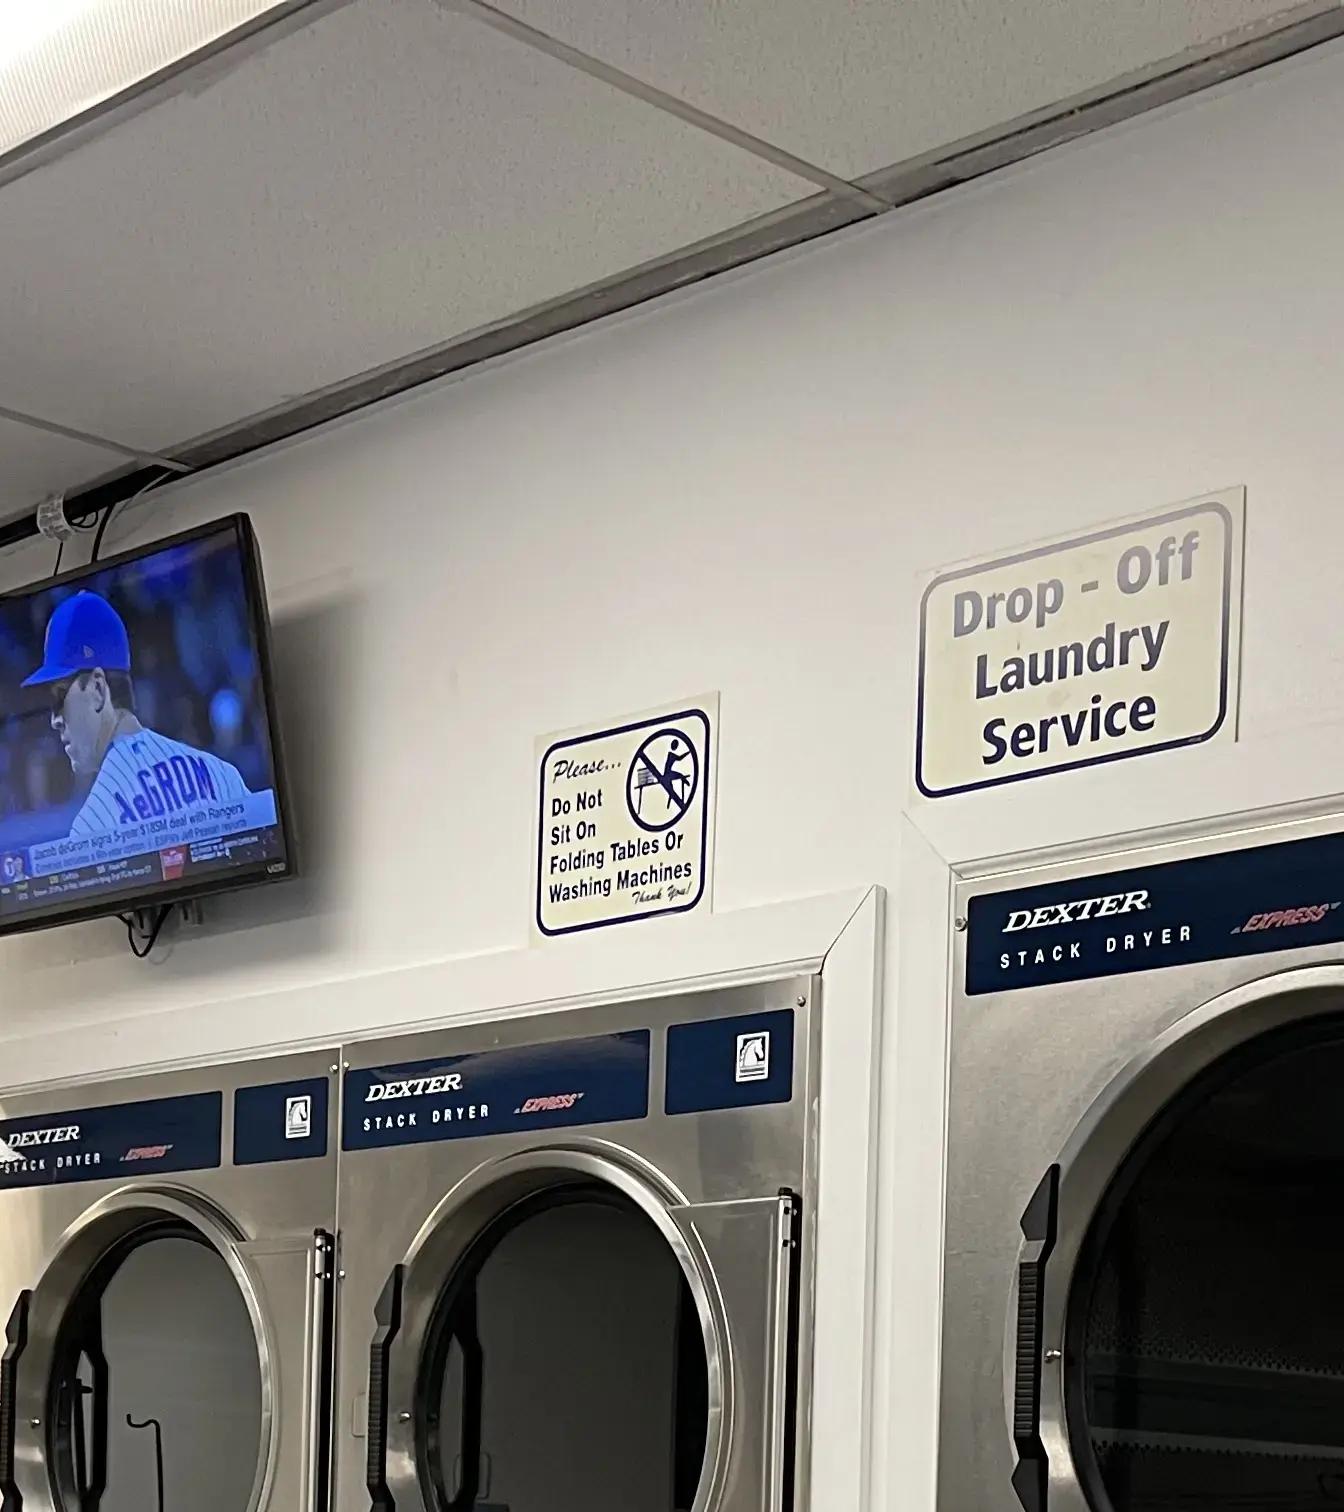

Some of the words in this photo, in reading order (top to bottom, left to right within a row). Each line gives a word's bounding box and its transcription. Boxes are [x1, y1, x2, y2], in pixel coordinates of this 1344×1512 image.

[954, 579, 1064, 638] Drop
[1117, 530, 1200, 594] Off
[975, 620, 1170, 699] Laundry
[981, 694, 1156, 765] Service
[208, 803, 244, 820] Rangers
[551, 797, 571, 817] Do
[576, 789, 603, 812] Not
[551, 824, 570, 845] Sit
[576, 821, 596, 840] On
[550, 849, 605, 875] Folding
[610, 837, 659, 862] Tables
[665, 831, 684, 850] Or
[549, 876, 611, 903] Washing
[617, 862, 692, 891] Machines
[631, 887, 662, 905] Thank
[666, 881, 692, 902] You!
[1002, 888, 1150, 934] DEXTER
[1241, 903, 1331, 932] EXPRESS
[1000, 940, 1081, 969] STACK
[1105, 924, 1194, 955] DRYER
[364, 1073, 461, 1102] DEXTER
[363, 1112, 417, 1132] STACK
[432, 1104, 490, 1123] DRYER
[8, 1125, 80, 1149] DEXTER
[4, 1158, 46, 1174] STACK
[56, 1152, 101, 1168] DRYER
